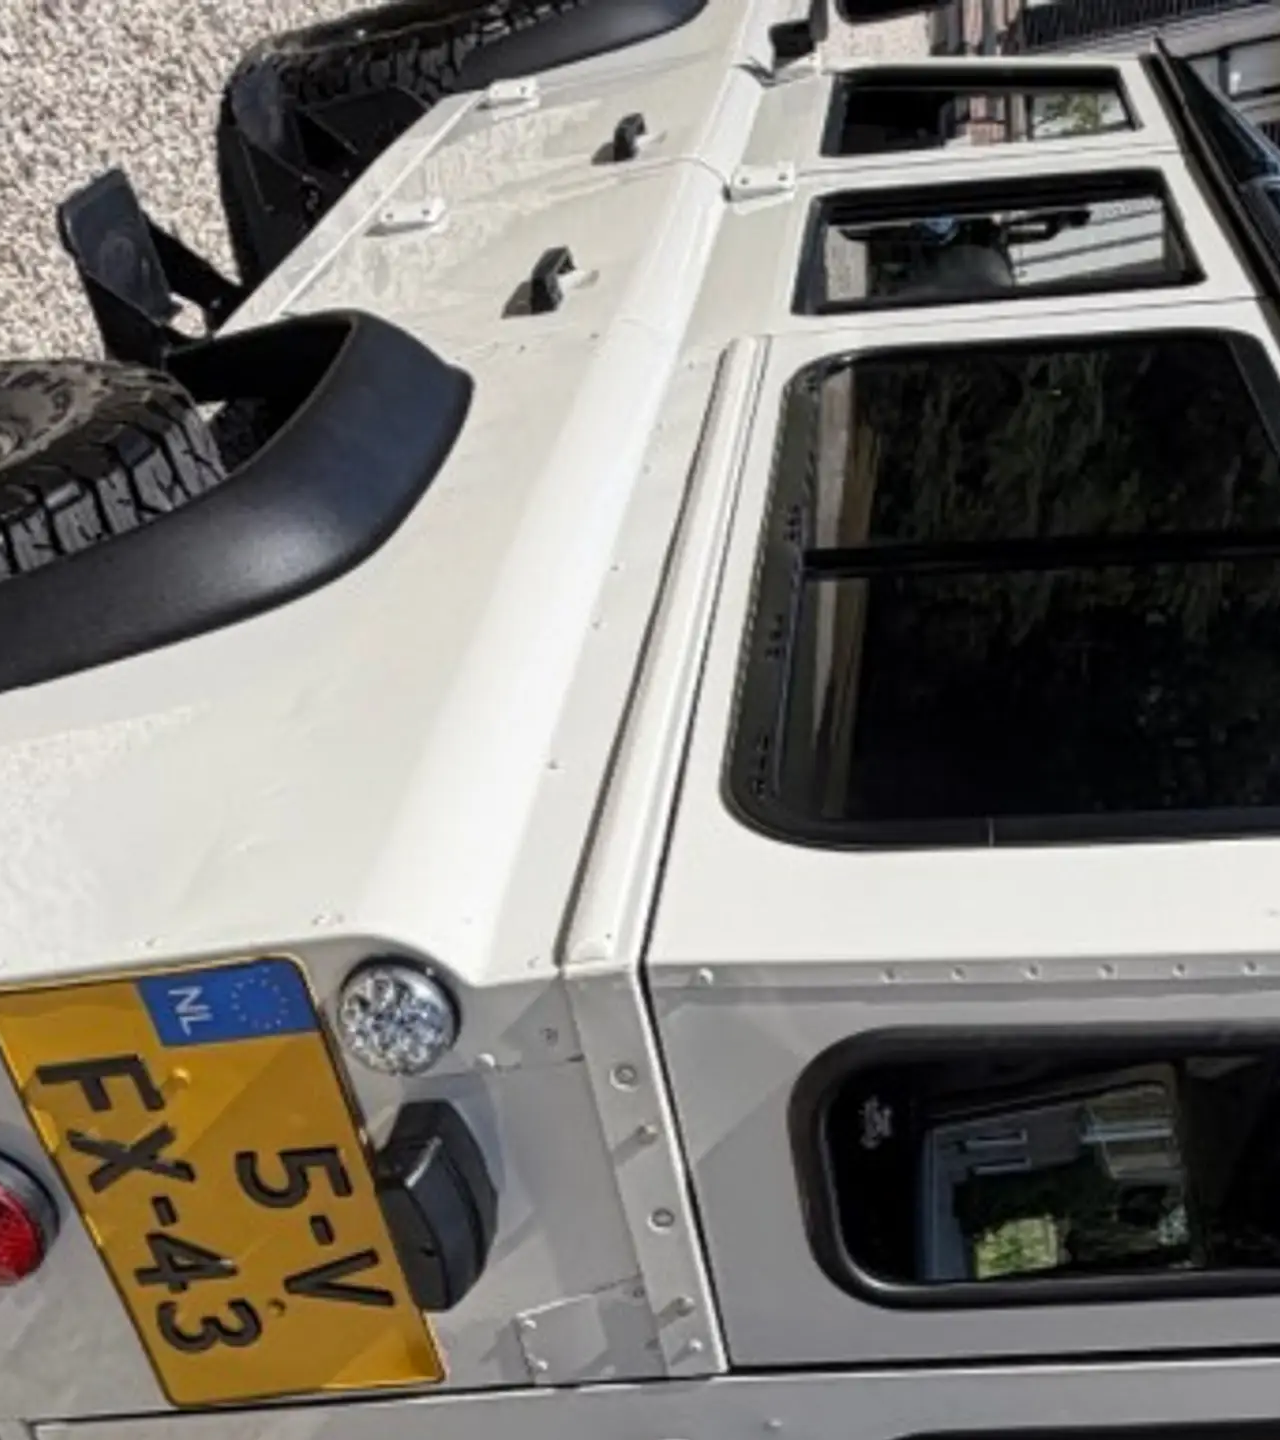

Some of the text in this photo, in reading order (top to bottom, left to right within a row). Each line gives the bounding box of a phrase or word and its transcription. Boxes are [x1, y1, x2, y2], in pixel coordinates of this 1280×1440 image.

[168, 986, 213, 1036] NL
[36, 1053, 264, 1352] FX-43
[235, 1145, 395, 1307] 5-V
